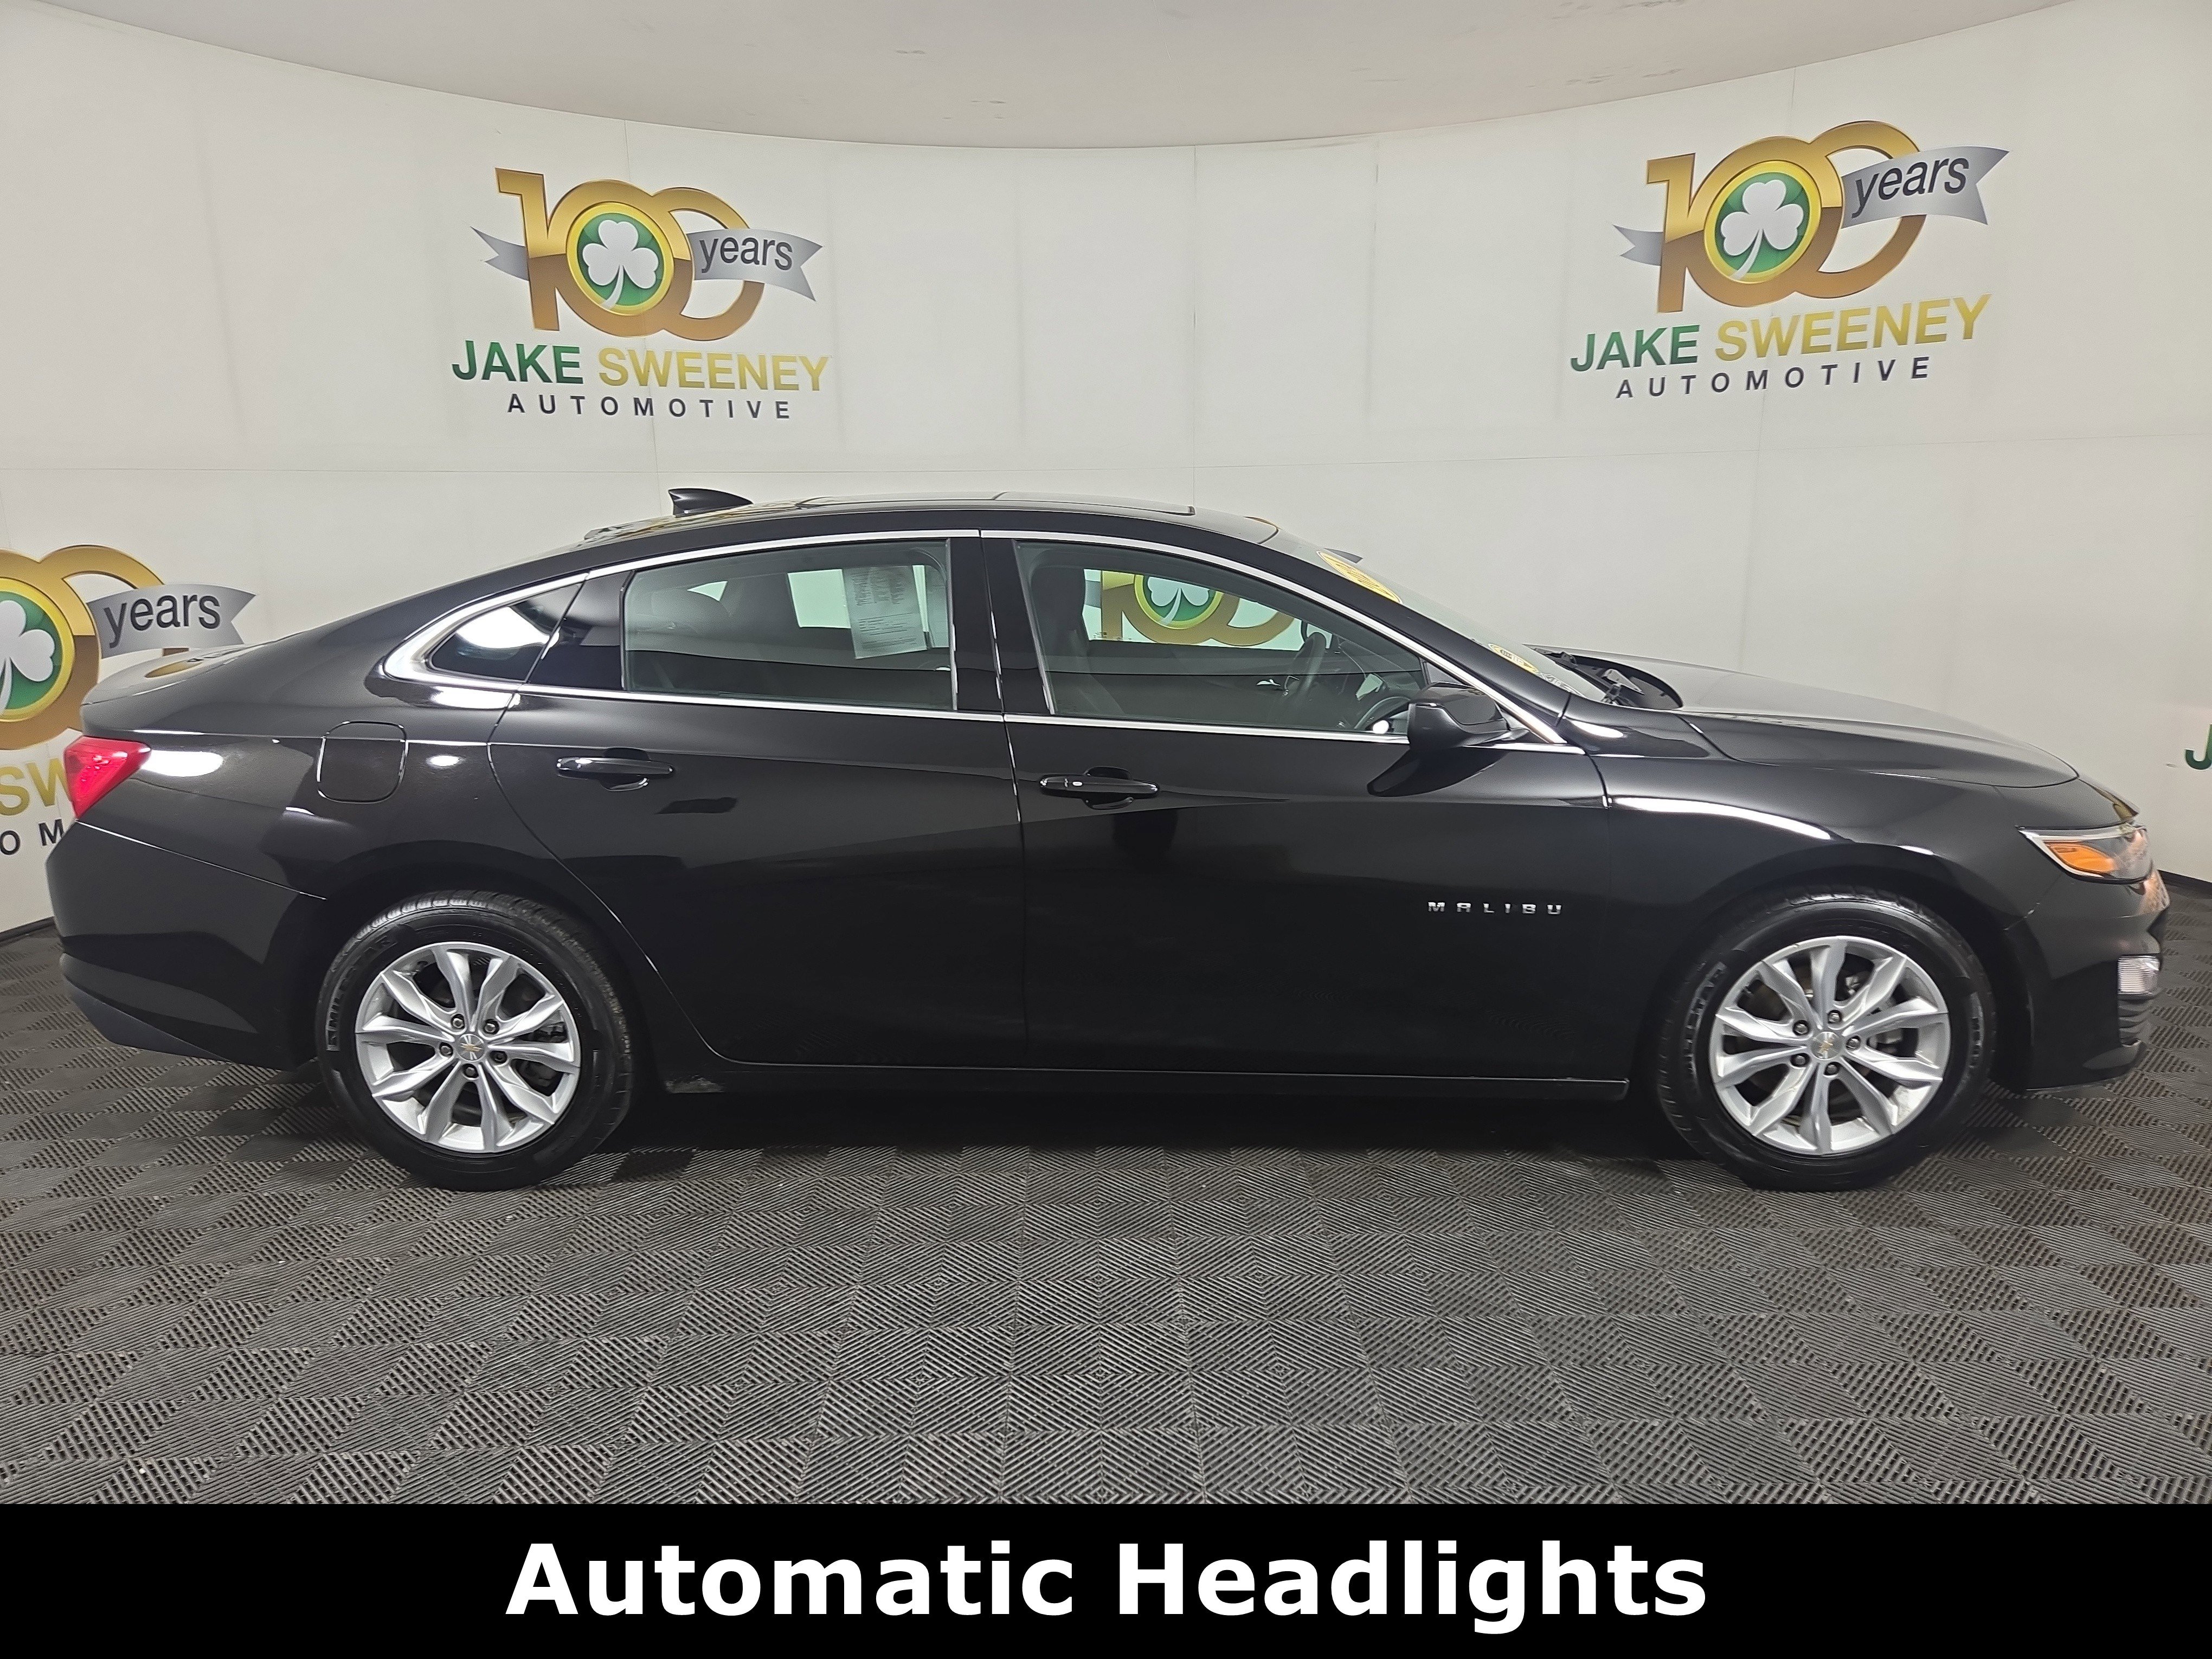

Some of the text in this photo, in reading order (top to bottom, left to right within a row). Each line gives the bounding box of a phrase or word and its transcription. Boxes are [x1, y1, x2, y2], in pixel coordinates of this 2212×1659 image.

[1852, 157, 1970, 218] years
[699, 236, 794, 273] years
[1570, 293, 1992, 372] JAKE SWEENEY
[452, 339, 829, 391] JAKE SWEENEY
[1616, 356, 1930, 400] AUTOMOTIVE
[507, 393, 790, 419] AUTOMOTIVE
[104, 594, 221, 649] years
[1427, 902, 1562, 915] MALIBU
